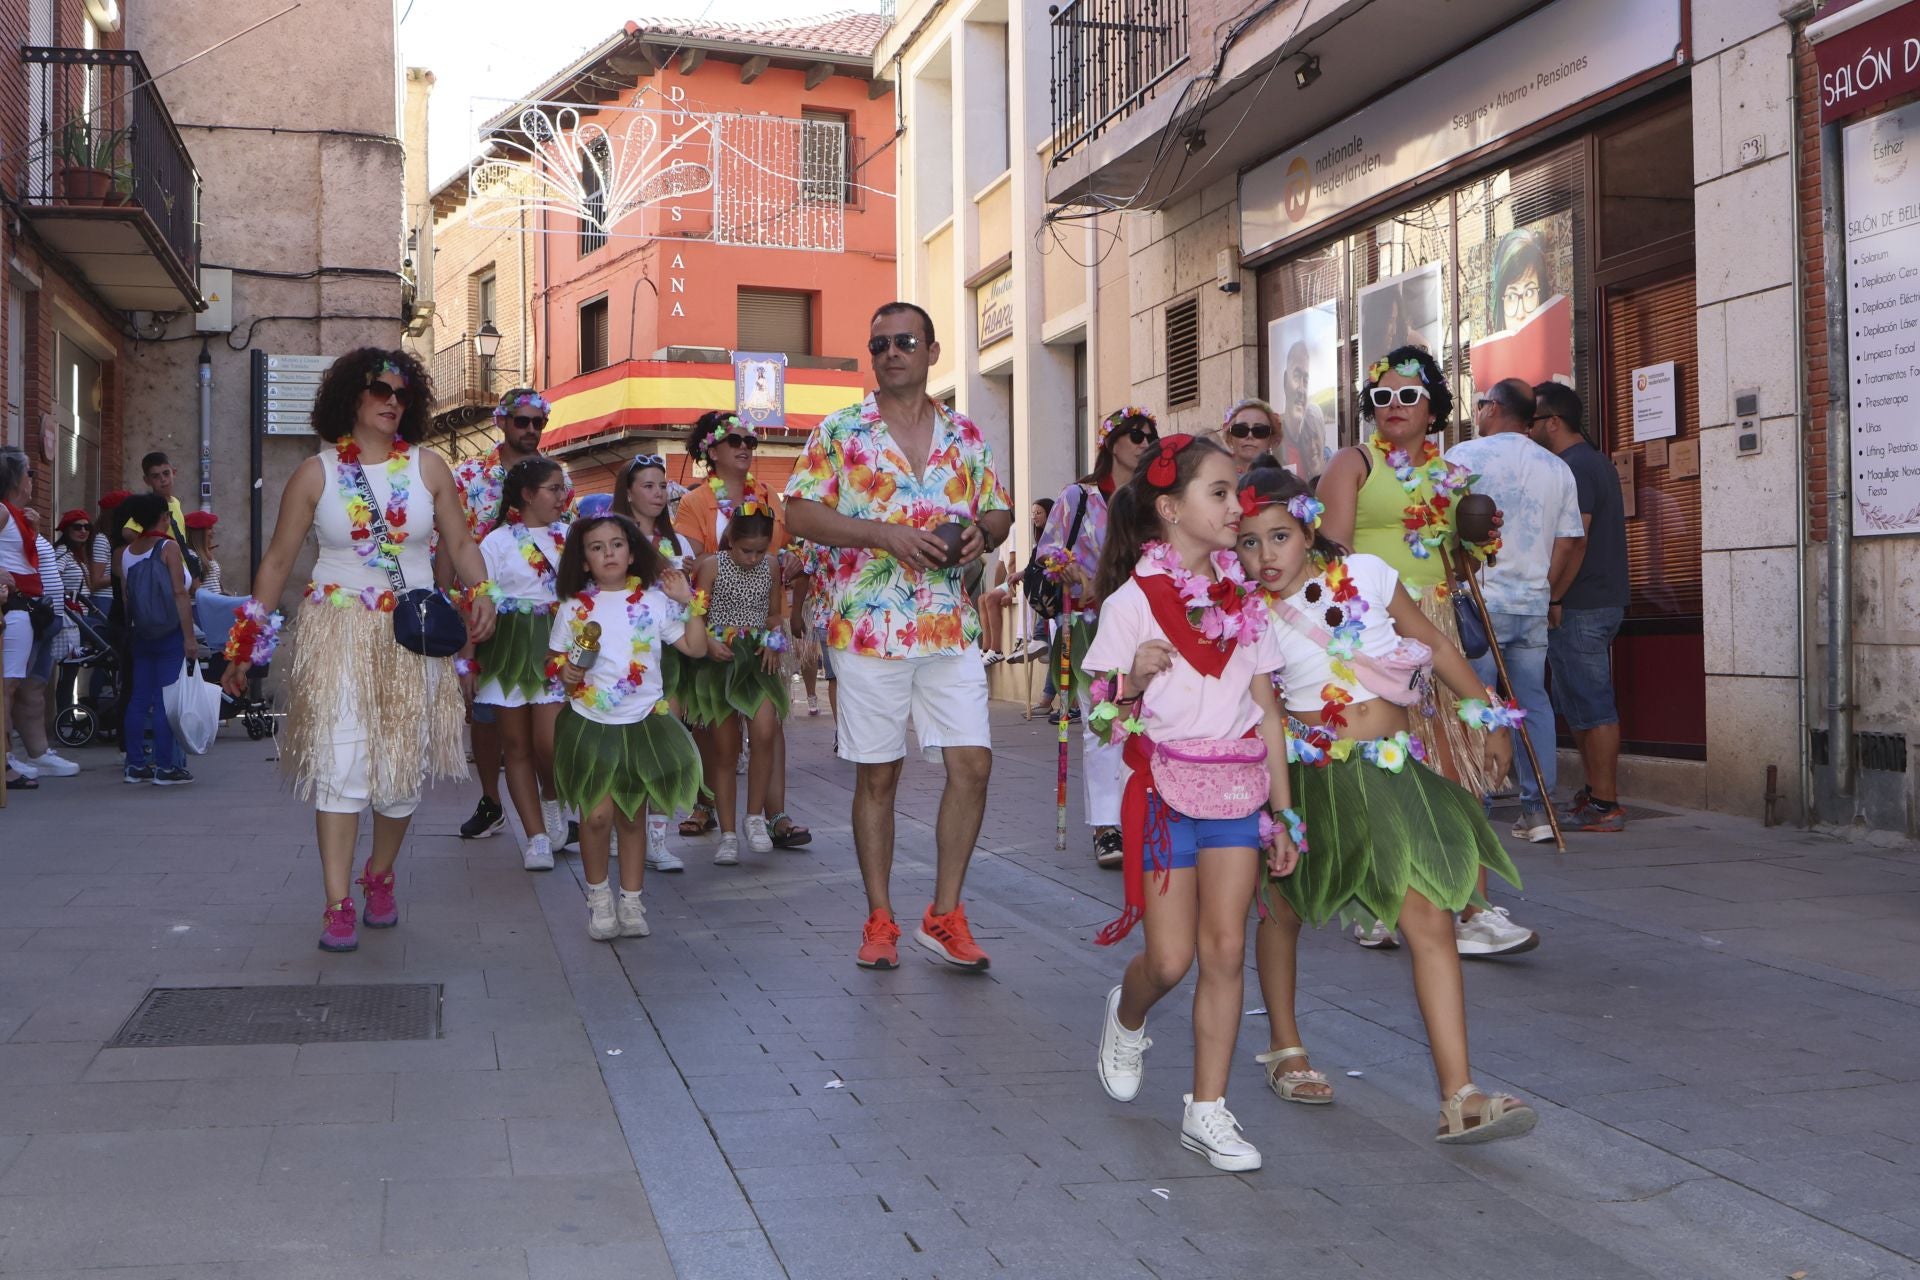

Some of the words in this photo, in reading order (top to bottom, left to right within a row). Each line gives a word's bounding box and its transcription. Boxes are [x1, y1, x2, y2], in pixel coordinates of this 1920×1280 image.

[1823, 47, 1892, 107] SALÓN
[1452, 102, 1488, 131] Seguros
[1496, 85, 1528, 110] Ahorro
[1536, 55, 1588, 90] Pensiones
[1315, 135, 1363, 174] nationale
[1873, 139, 1904, 160] Esther
[1315, 153, 1381, 198] nederlanden
[1848, 214, 1878, 237] SALÓN
[1881, 210, 1894, 227] DE
[1860, 250, 1889, 265] Solarium
[671, 253, 685, 316] ANA
[1862, 272, 1896, 289] Depilación
[1899, 266, 1918, 279] Cera
[1862, 297, 1896, 316] Depilación
[1863, 321, 1897, 339] Depilación
[1900, 318, 1919, 330] Láser
[1863, 349, 1892, 363] Limpieza
[1894, 341, 1916, 355] Facial
[1864, 370, 1907, 384] Tratamientos
[1866, 394, 1909, 409] Presoterapia
[1865, 422, 1882, 433] Uñas
[1866, 445, 1885, 459] Lifting
[1888, 442, 1919, 454] Pestañas
[1867, 467, 1899, 482] Maquillaje
[355, 476, 376, 511] BIMBA
[1868, 485, 1888, 497] Fiesta
